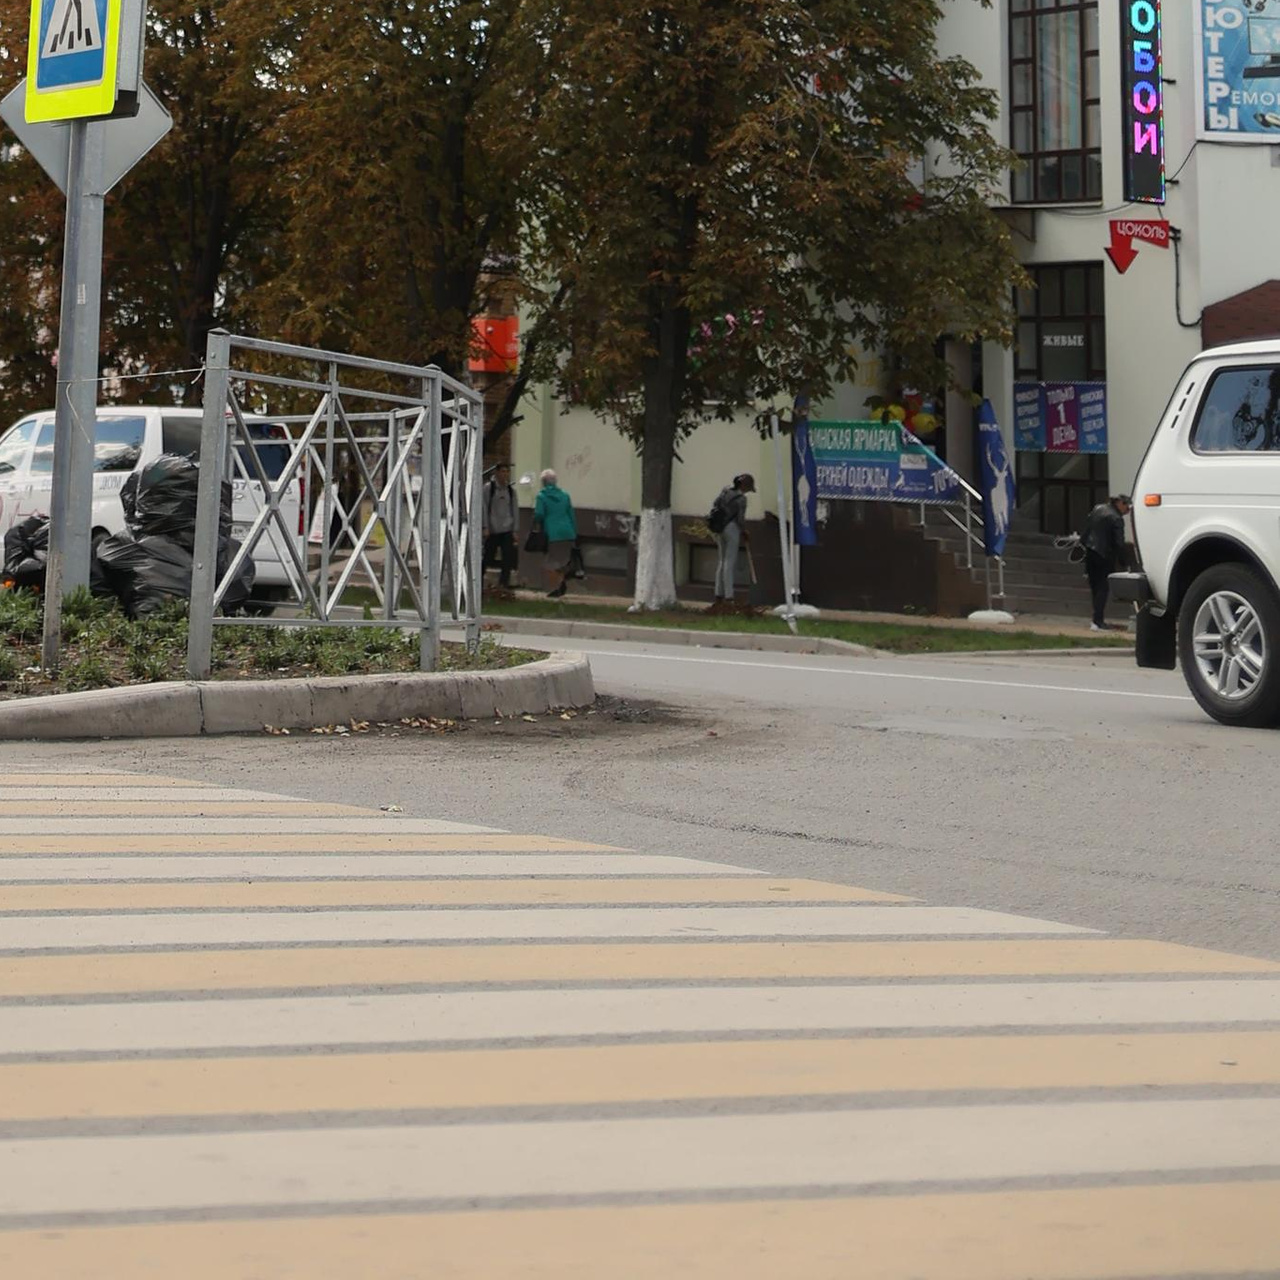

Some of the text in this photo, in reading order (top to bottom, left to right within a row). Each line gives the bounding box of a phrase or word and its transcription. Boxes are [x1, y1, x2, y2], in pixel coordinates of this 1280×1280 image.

[1130, 0, 1158, 155] ОБОИ
[1117, 221, 1167, 240] ЦОКОЛЬ
[1042, 334, 1084, 347] ЖИВЫЕ
[1047, 386, 1075, 404] ТОЛЬКО
[1057, 403, 1066, 424] 1
[852, 428, 898, 452] ЯРМАРКА
[1052, 424, 1077, 446] ДЕНЬ
[816, 462, 889, 491] ЕРХНЕЙ ОДЕЖДЫ
